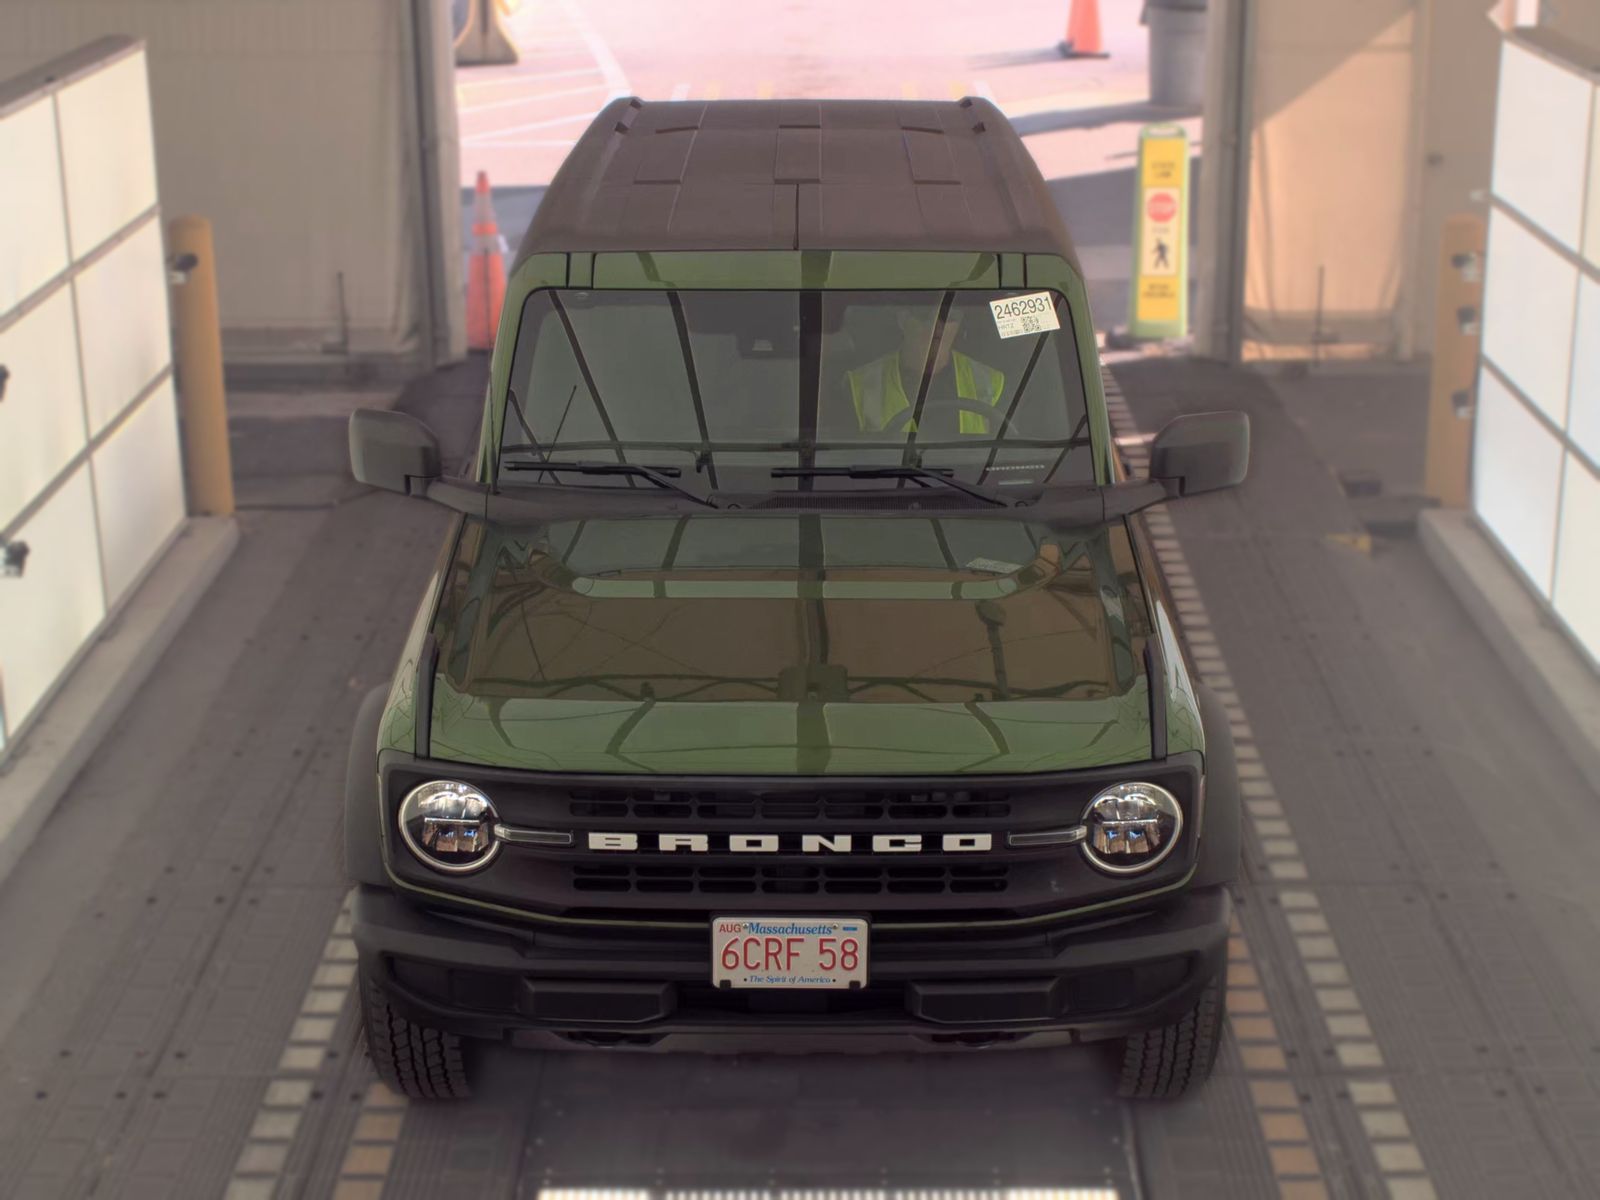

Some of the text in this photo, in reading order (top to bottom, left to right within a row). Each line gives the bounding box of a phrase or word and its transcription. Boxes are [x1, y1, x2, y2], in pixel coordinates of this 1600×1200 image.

[994, 296, 1052, 320] 2462931
[588, 832, 992, 852] BRONCO
[719, 923, 742, 933] AUG
[748, 922, 832, 935] Massachusetts
[721, 937, 859, 971] 6CRF 58
[750, 975, 831, 984] The Spirit of America
